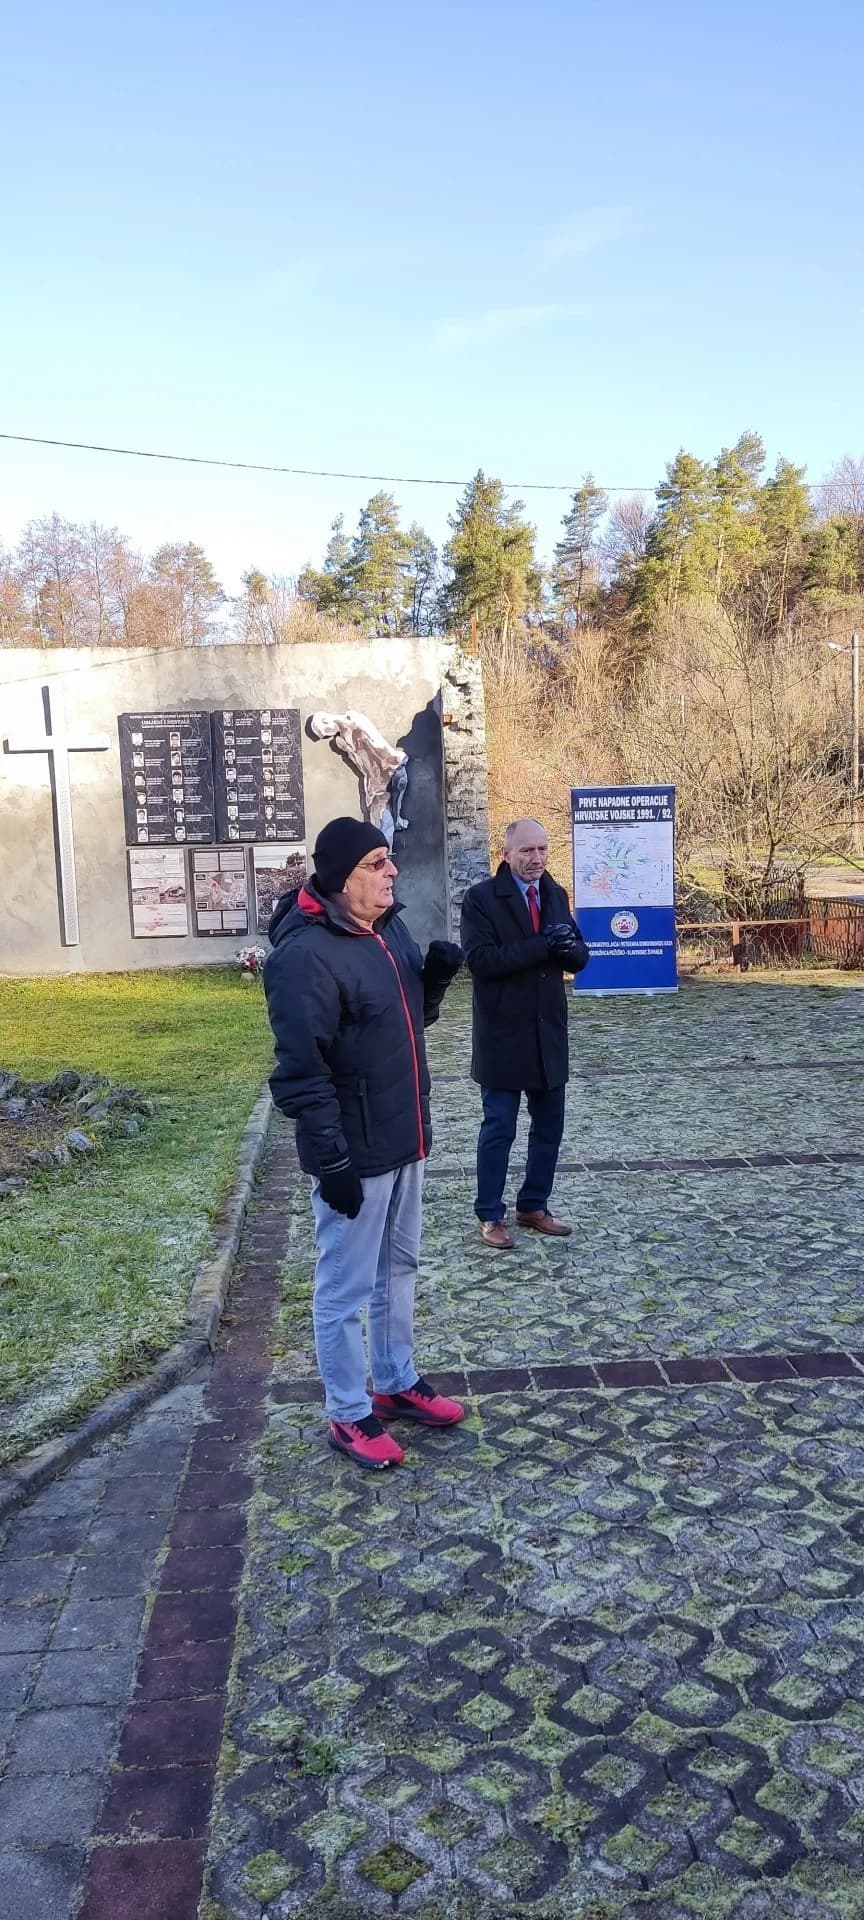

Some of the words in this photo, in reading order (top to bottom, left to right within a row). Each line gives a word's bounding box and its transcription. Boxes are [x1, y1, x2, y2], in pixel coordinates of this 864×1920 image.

[578, 797, 597, 808] PRVE
[598, 796, 630, 808] NAPADNE
[631, 795, 668, 807] OPERACIJE
[574, 810, 609, 821] HRVATSKE
[610, 809, 636, 820] VOJSKE
[636, 809, 656, 820] 1991.
[662, 808, 673, 819] 92.
